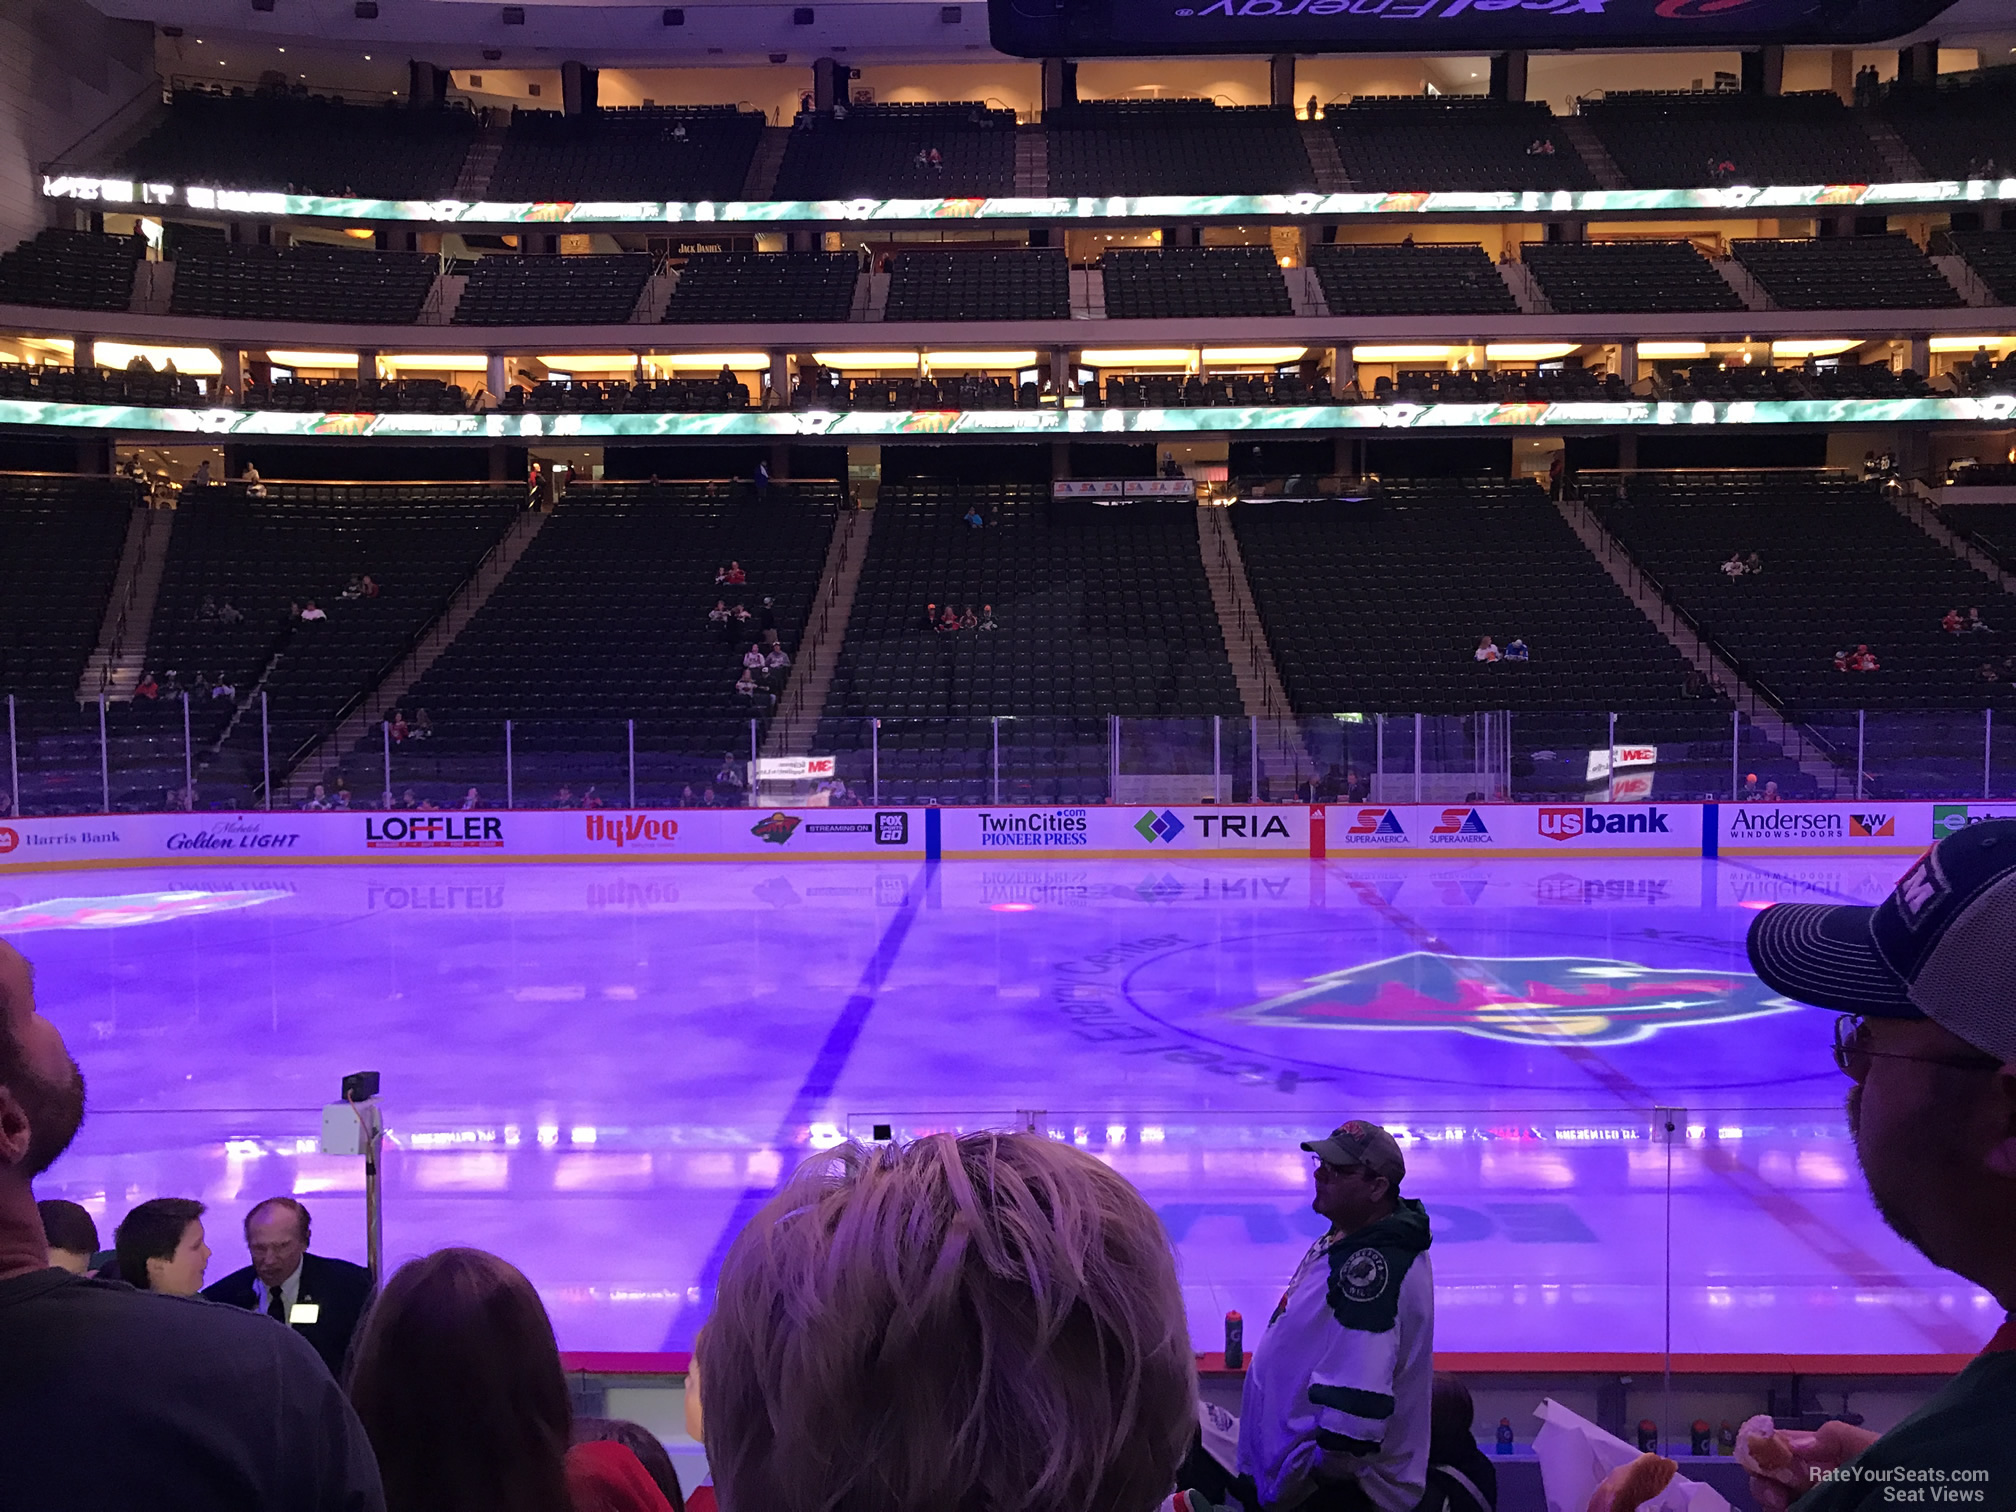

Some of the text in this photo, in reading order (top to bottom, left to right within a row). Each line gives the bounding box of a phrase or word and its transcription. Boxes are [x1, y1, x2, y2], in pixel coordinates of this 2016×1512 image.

[879, 815, 903, 826] FOX
[978, 813, 1087, 832] TwinCities
[1193, 815, 1291, 838] TRIA
[1731, 808, 1841, 831] Andersen
[366, 817, 504, 840] LOFFLER
[585, 815, 678, 848] HyVee
[880, 830, 903, 841] GO
[25, 831, 121, 846] Harris Bank
[166, 831, 300, 851] Golden LIGHT
[982, 833, 1088, 846] PIONEER PRESS
[1345, 835, 1409, 844] SUPERAMERICA
[1429, 835, 1493, 844] SUPERAMERICA
